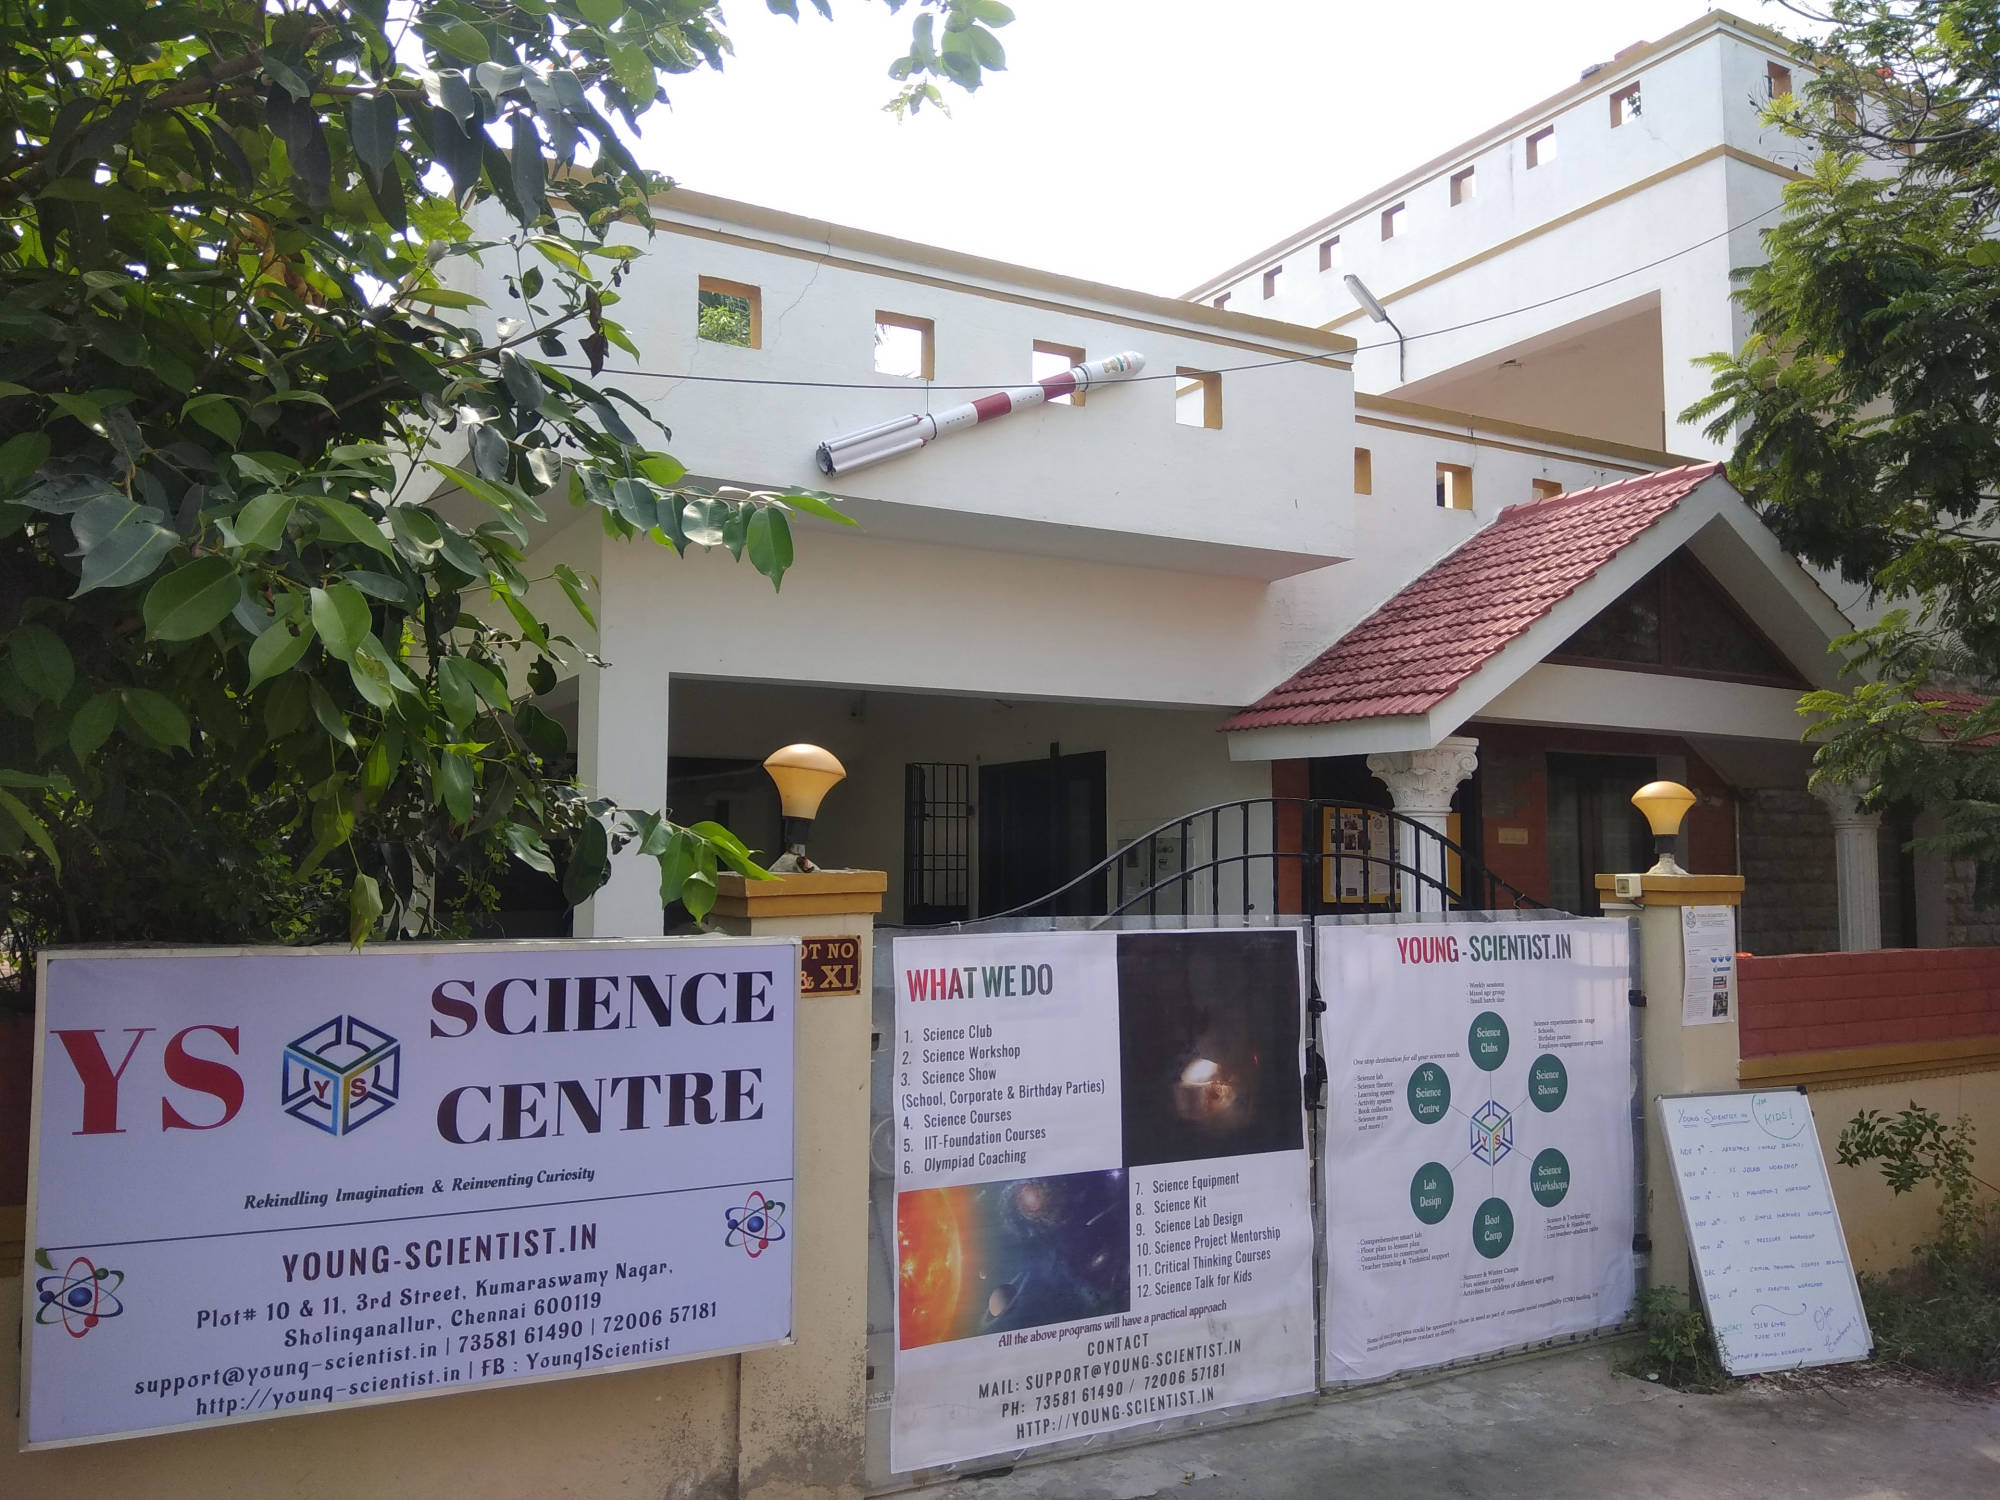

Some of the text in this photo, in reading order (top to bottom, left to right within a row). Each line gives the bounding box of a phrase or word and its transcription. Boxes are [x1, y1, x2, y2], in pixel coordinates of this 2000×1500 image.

[828, 942, 854, 959] NO
[820, 965, 853, 988] XI
[907, 964, 1053, 1002] WHAT WE DO
[430, 970, 775, 1039] SCIENCE
[904, 1025, 992, 1043] 1. Science Club
[1477, 1027, 1500, 1038] Science
[902, 1045, 1020, 1065] 2. Science Workshop
[1481, 1043, 1498, 1053] Clubs
[1365, 1058, 1375, 1066] stop
[1376, 1056, 1402, 1064] destination
[1402, 1054, 1410, 1064] for
[50, 1024, 244, 1136] YS
[901, 1068, 997, 1086] 3. Science Show
[1423, 1070, 1433, 1081] YS
[1536, 1070, 1559, 1080] Science
[902, 1079, 1105, 1111] (School, Corporate & Birthday Parties)
[1416, 1087, 1441, 1098] Science
[1538, 1085, 1558, 1095] Shows
[436, 1067, 764, 1145] CENTRE
[1358, 1099, 1376, 1107] Activity
[1419, 1104, 1439, 1114] Centre
[903, 1109, 1012, 1130] 4. Science Courses
[904, 1127, 1046, 1152] 5. IIT-Foundation Courses
[904, 1150, 1027, 1174] 6. Olympiad Coaching
[1539, 1166, 1561, 1176] Science
[244, 1168, 595, 1210] Rekindling Imagination & Reinventing Curiosity
[1135, 1172, 1240, 1195] 7. Science Equipment
[1424, 1179, 1436, 1190] Lab
[1533, 1181, 1568, 1192] Workshops
[1136, 1196, 1206, 1215] 8. Science Kit
[1420, 1196, 1441, 1208] Design
[1136, 1212, 1243, 1236] 9. Science Lab Design
[1485, 1215, 1499, 1225] Boot
[1137, 1227, 1281, 1256] 10. Science Project Mentorship
[1485, 1231, 1502, 1242] Camp
[282, 1223, 597, 1282] YOUNG-SCIENTIST.IN
[1137, 1250, 1271, 1277] 11. Critical Thinking Courses
[1362, 1263, 1381, 1271] Teacher
[196, 1308, 256, 1329] Plot#
[267, 1301, 290, 1320] 10
[300, 1300, 313, 1316] &
[356, 1291, 391, 1311] 3rd
[400, 1285, 466, 1305] Street,
[476, 1269, 608, 1298] Kumaraswamy
[616, 1261, 673, 1283] Nagar,
[1137, 1270, 1252, 1298] 12. Science Talk for Kids
[284, 1292, 602, 1347] Sholinganallur, Chennai 600119
[999, 1300, 1227, 1347] All the above programs will have a practical approach
[135, 1302, 717, 1398] support@young-scientist.in 73581 61490 72006 57181
[1088, 1333, 1149, 1357] CONTACT
[196, 1370, 460, 1416] http://young-scientist.in
[482, 1358, 504, 1377] FB
[526, 1336, 670, 1370] Young1Scientist
[978, 1339, 1242, 1399] MAIL: SUPPORT@YOUNG-SCIENTIST.IN
[1002, 1363, 1226, 1417] PH: 73581 61490 / 72006 57181
[1016, 1387, 1215, 1439] HTTP://YOUNG-SCIENTIST.IN
